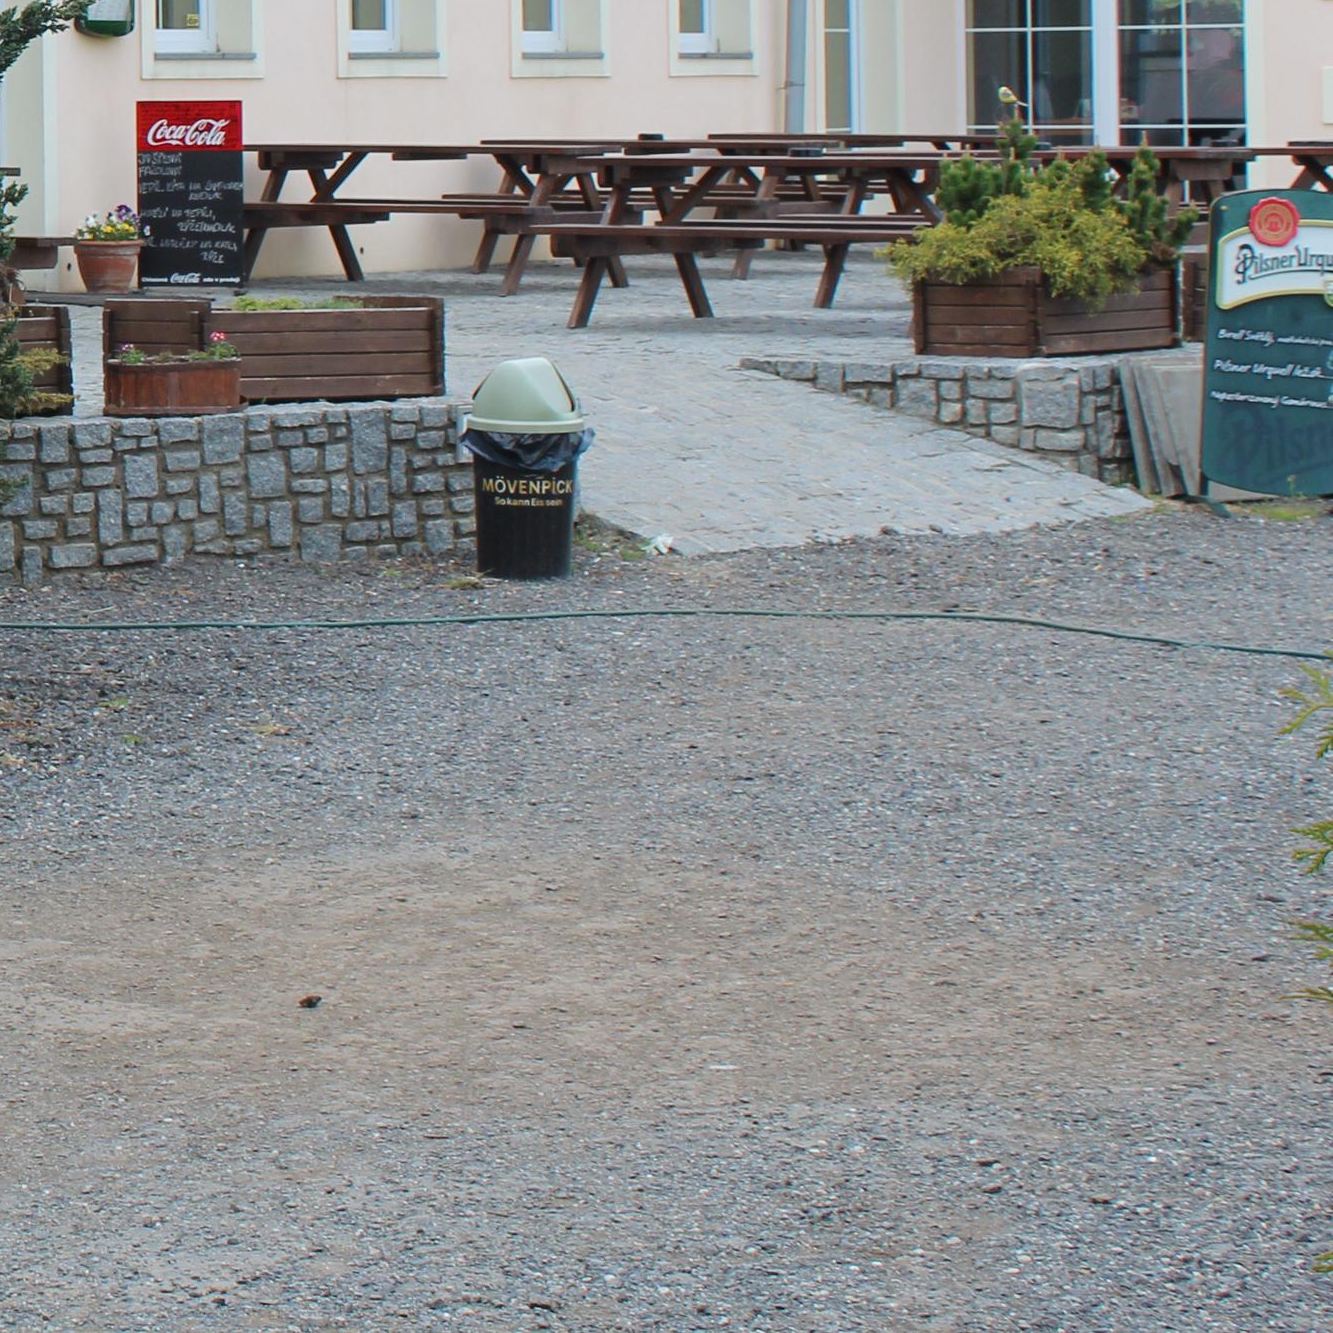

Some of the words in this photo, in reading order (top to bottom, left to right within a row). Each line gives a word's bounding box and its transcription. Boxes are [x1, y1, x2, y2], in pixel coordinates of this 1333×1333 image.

[147, 119, 231, 146] Coca-Cola
[1235, 244, 1296, 284] Pilsner
[1252, 363, 1294, 379] Urquell
[482, 475, 573, 495] MÖVENPICK
[494, 496, 505, 506] So
[507, 497, 530, 506] kann
